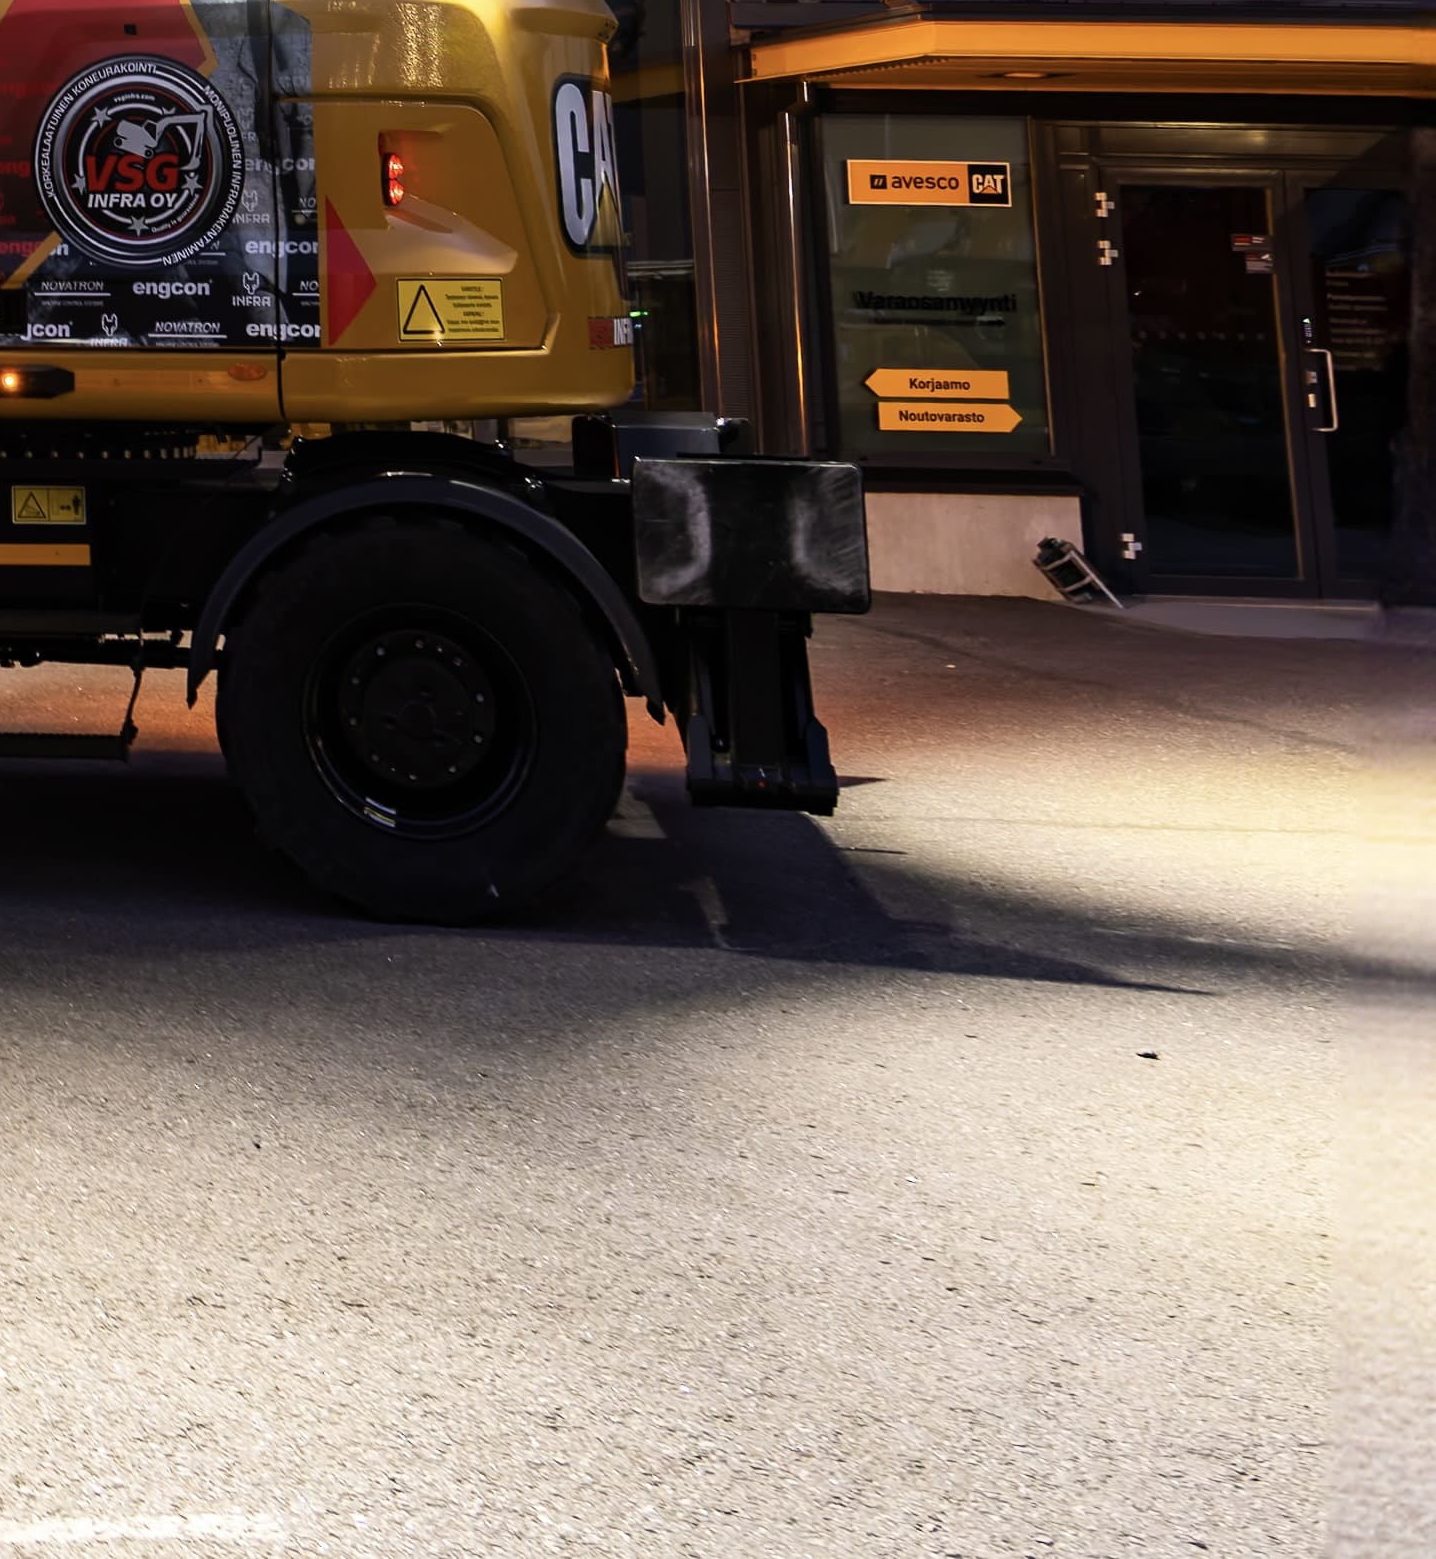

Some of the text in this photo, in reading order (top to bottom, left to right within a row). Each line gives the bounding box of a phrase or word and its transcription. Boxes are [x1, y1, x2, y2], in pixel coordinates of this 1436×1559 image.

[40, 62, 158, 198] KORKEALAATUINEN KONEURAKOINTI
[202, 85, 242, 169] MONIPUOLINEN
[85, 152, 180, 193] VSG
[555, 83, 624, 245] CA
[891, 174, 960, 190] avesco
[972, 173, 1005, 195] CAT
[87, 192, 179, 209] INFRA OY
[162, 170, 241, 267] INFRARAKENTAMINEN
[41, 281, 104, 291] NOVATRON
[132, 280, 212, 299] engcon
[232, 296, 272, 308] INFRA
[855, 291, 1017, 314] Varaosamyynti
[155, 322, 220, 334] NOVATRON
[909, 378, 971, 392] Korjaamo
[899, 410, 985, 424] Noutovarasto
